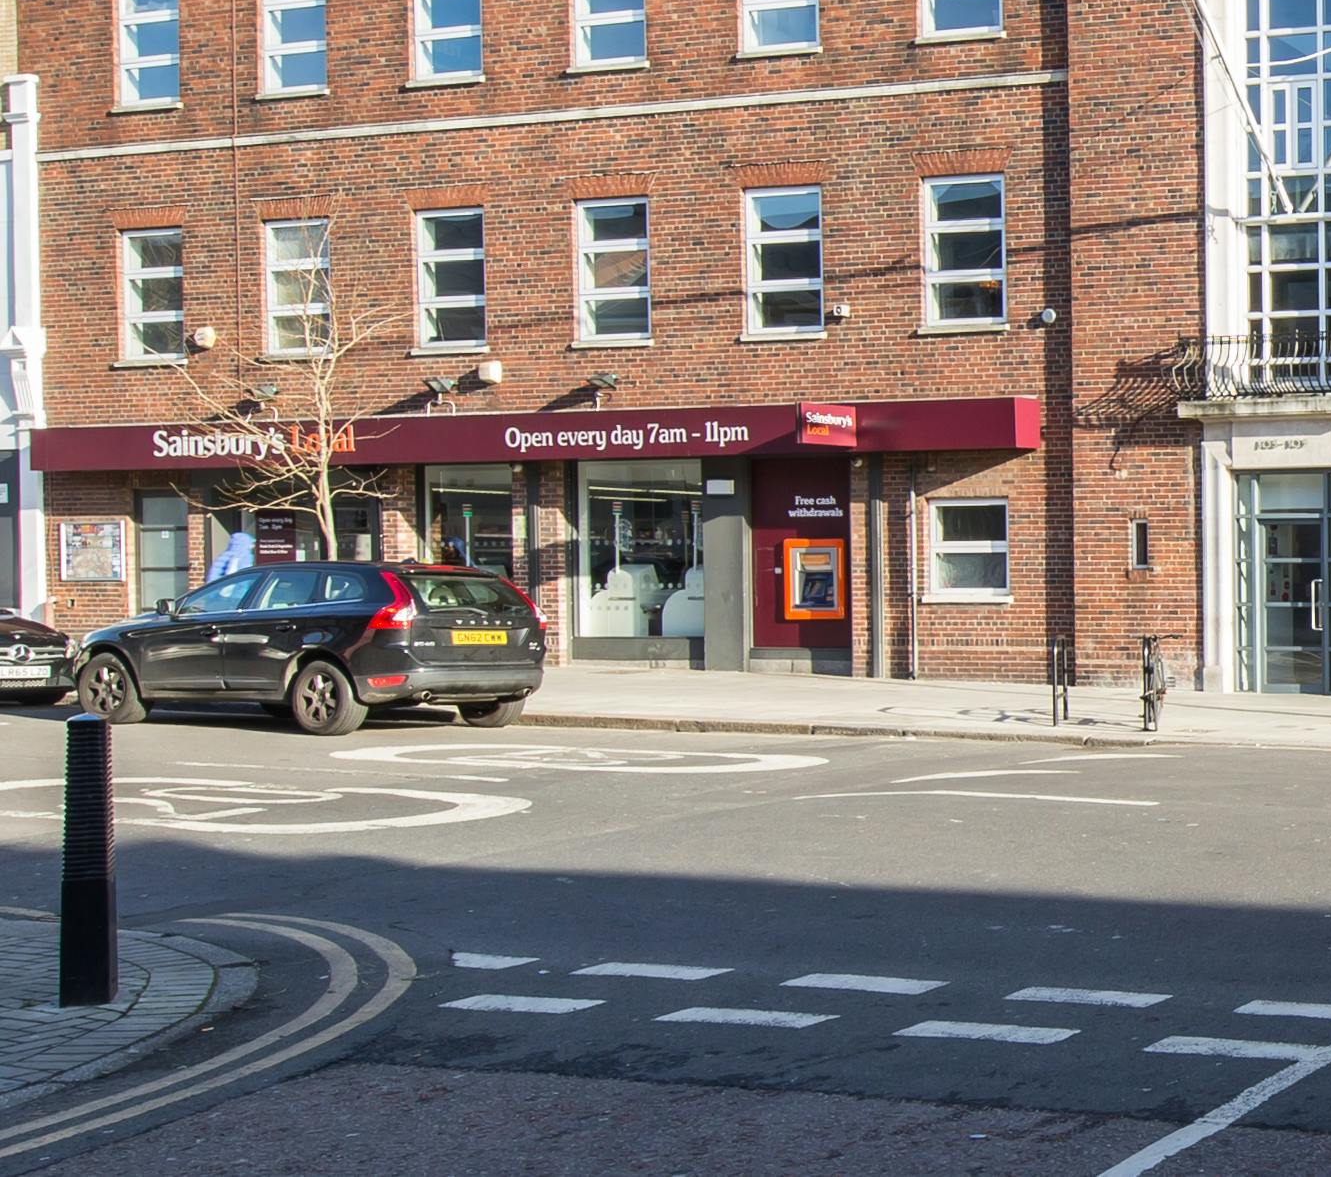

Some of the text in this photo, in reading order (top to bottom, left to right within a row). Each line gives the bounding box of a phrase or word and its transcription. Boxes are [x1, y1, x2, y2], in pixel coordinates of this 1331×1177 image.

[806, 411, 853, 428] Sainsbury's
[504, 426, 553, 453] Open
[556, 428, 607, 451] every
[610, 424, 644, 450] day
[646, 422, 687, 444] 7am
[705, 421, 749, 447] 11pm
[807, 424, 830, 436] Local
[153, 423, 356, 461] Sainsbury's Loal
[794, 495, 836, 506] Free cash
[788, 508, 844, 518] withdrawals
